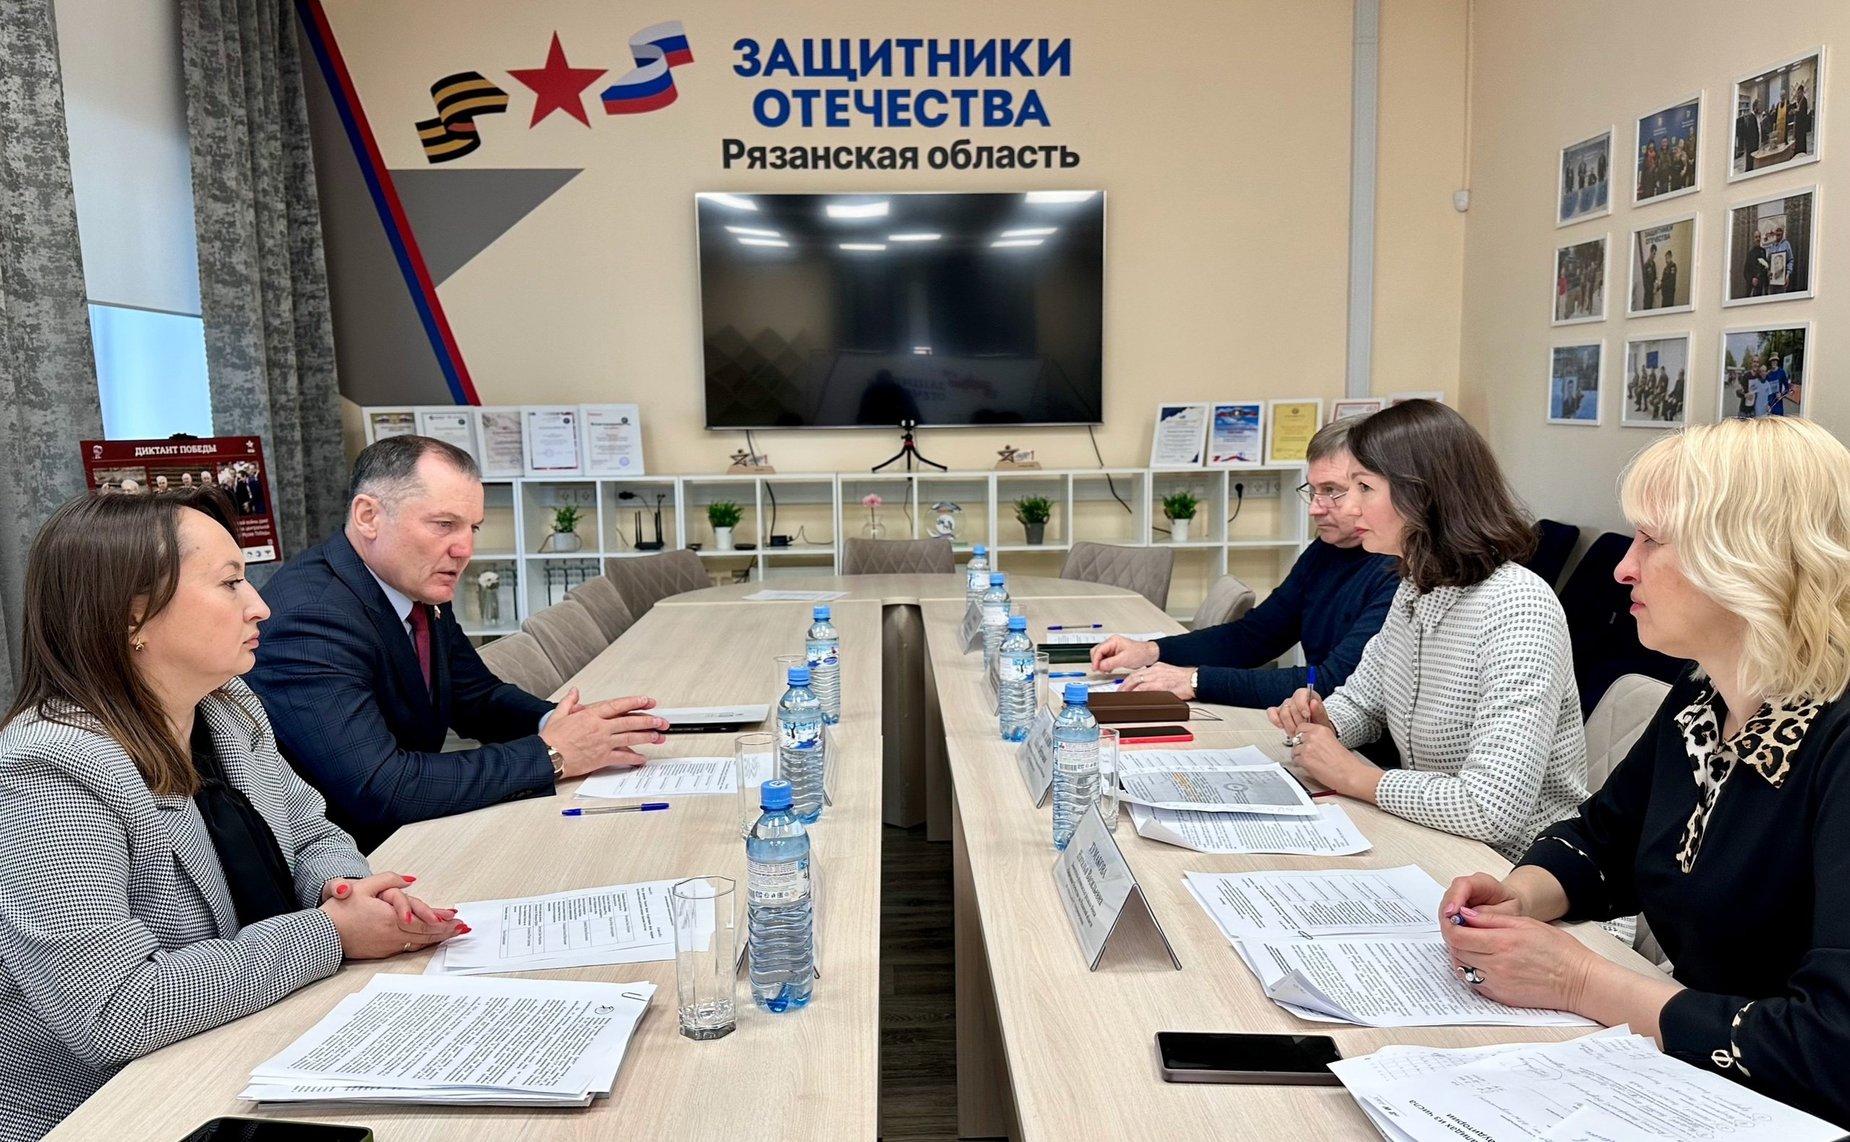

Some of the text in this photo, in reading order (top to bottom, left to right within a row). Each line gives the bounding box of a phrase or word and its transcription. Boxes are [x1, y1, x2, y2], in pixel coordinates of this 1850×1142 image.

[733, 38, 1071, 82] ЗАЩИТНИКИ
[752, 88, 1050, 128] ОТЕЧЕСТВА
[722, 138, 1080, 170] Рязанская область
[135, 444, 217, 457] ДИКТАНТ ПОБЕДЫ
[1409, 1099, 1433, 1117] числа
[1447, 1113, 1496, 1142] аудитории
